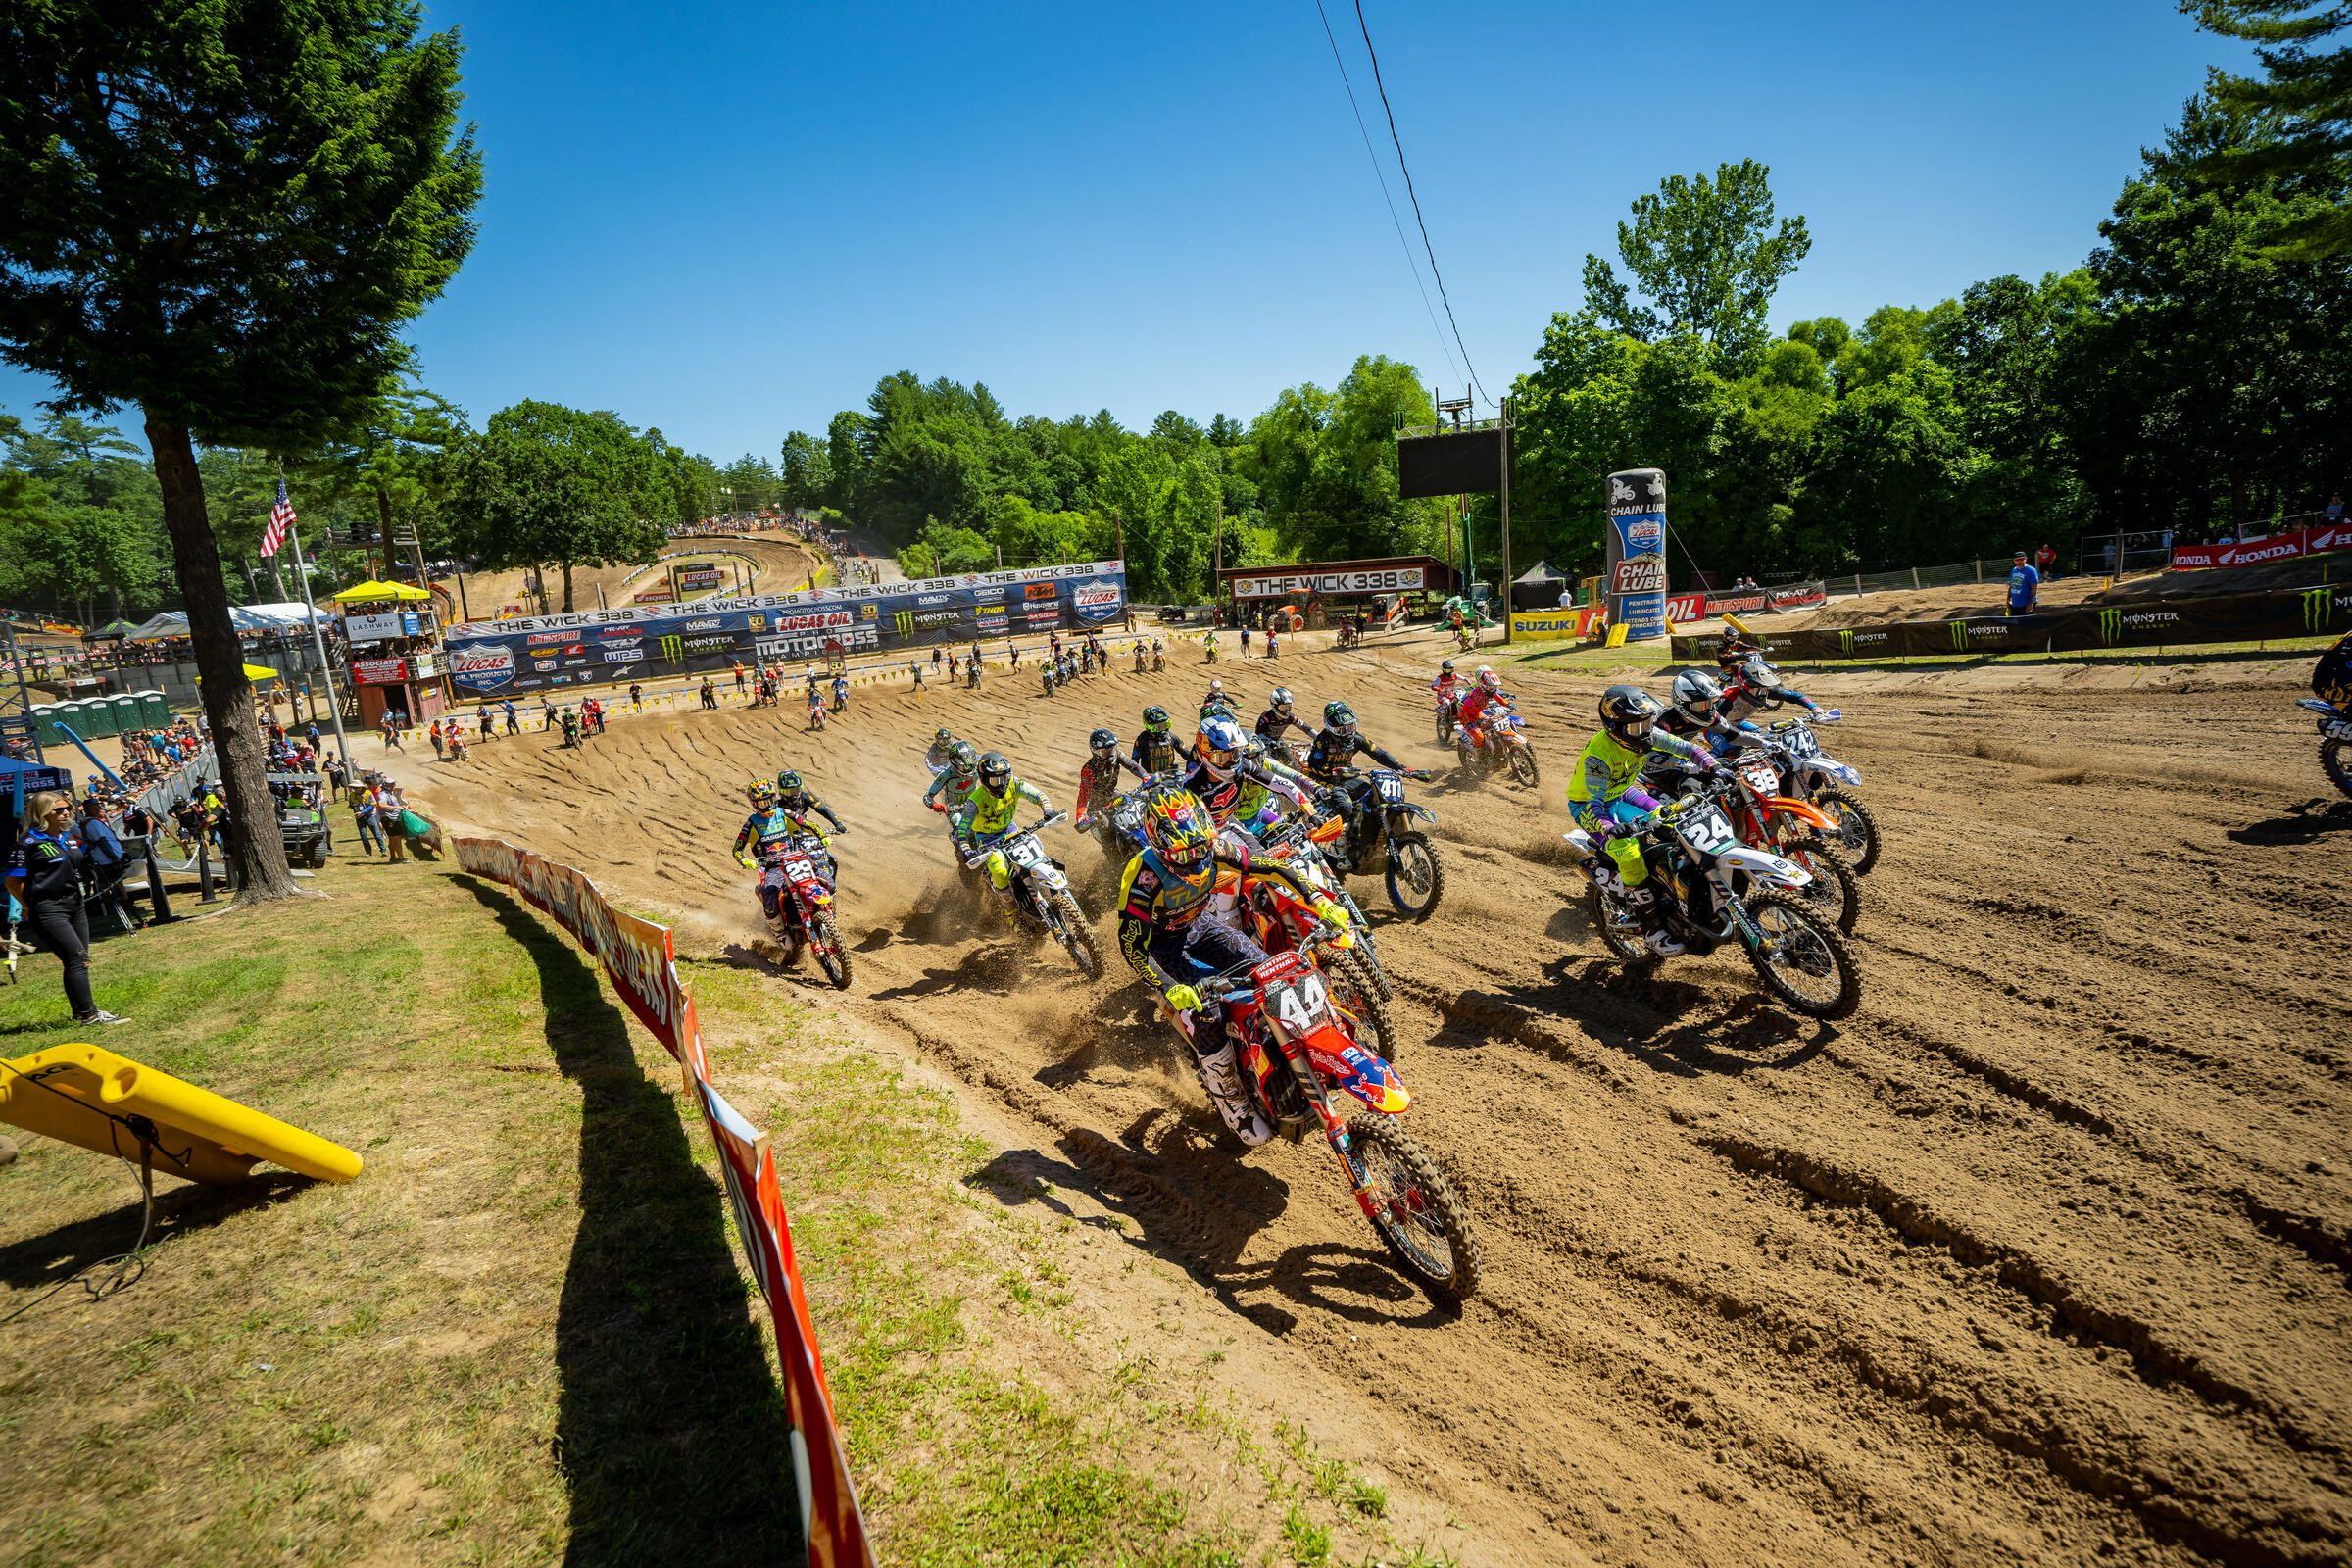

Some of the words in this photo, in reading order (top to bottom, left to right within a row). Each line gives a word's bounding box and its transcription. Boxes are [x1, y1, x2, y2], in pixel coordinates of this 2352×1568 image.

[1611, 505, 1643, 516] CHAIN
[2233, 544, 2299, 564] HONDA
[984, 572, 1016, 583] THE
[1021, 569, 1060, 580] WICK
[1065, 565, 1094, 575] 338
[1619, 563, 1664, 579] CHAIN
[837, 588, 872, 599] THE
[878, 582, 918, 595] WICK
[924, 579, 956, 590] 338
[1255, 578, 1296, 594] THE
[1299, 574, 1349, 591] WICK
[1354, 571, 1397, 589] 338
[1621, 576, 1663, 591] LUBE
[974, 588, 1004, 597] GEICO
[1081, 592, 1117, 605] LUCAS
[668, 603, 708, 614] THE
[712, 597, 760, 612] WICK
[764, 594, 799, 607] 338
[1666, 598, 1697, 622] OIL
[353, 621, 394, 631] LASHWAY
[492, 620, 534, 632] THE
[541, 613, 591, 628] WICK
[597, 611, 634, 622] 338
[779, 614, 827, 632] LUCAS
[828, 612, 851, 627] OIL
[915, 612, 959, 623] MONSTER
[1514, 620, 1575, 632] SUZUKI
[2123, 612, 2180, 624] MONSTER
[1853, 633, 1888, 642] MONSTER
[1968, 626, 2008, 635] MONSTER
[684, 636, 735, 649] MONSTER
[354, 659, 403, 668] ASSOCIATED
[457, 657, 508, 672] LUCAS
[605, 649, 643, 662] WPS
[470, 670, 512, 680] PRODUCTS
[2325, 720, 2352, 741] 59
[1381, 779, 1401, 798] 411
[1747, 768, 1779, 793] 38
[1687, 813, 1734, 853] 24
[1012, 839, 1044, 864] 31
[786, 859, 812, 882] 29
[1595, 867, 1625, 898] 24
[1734, 901, 1763, 936] DUNLOP
[1260, 957, 1296, 979] RENTHAL
[1280, 973, 1326, 1030] 44
